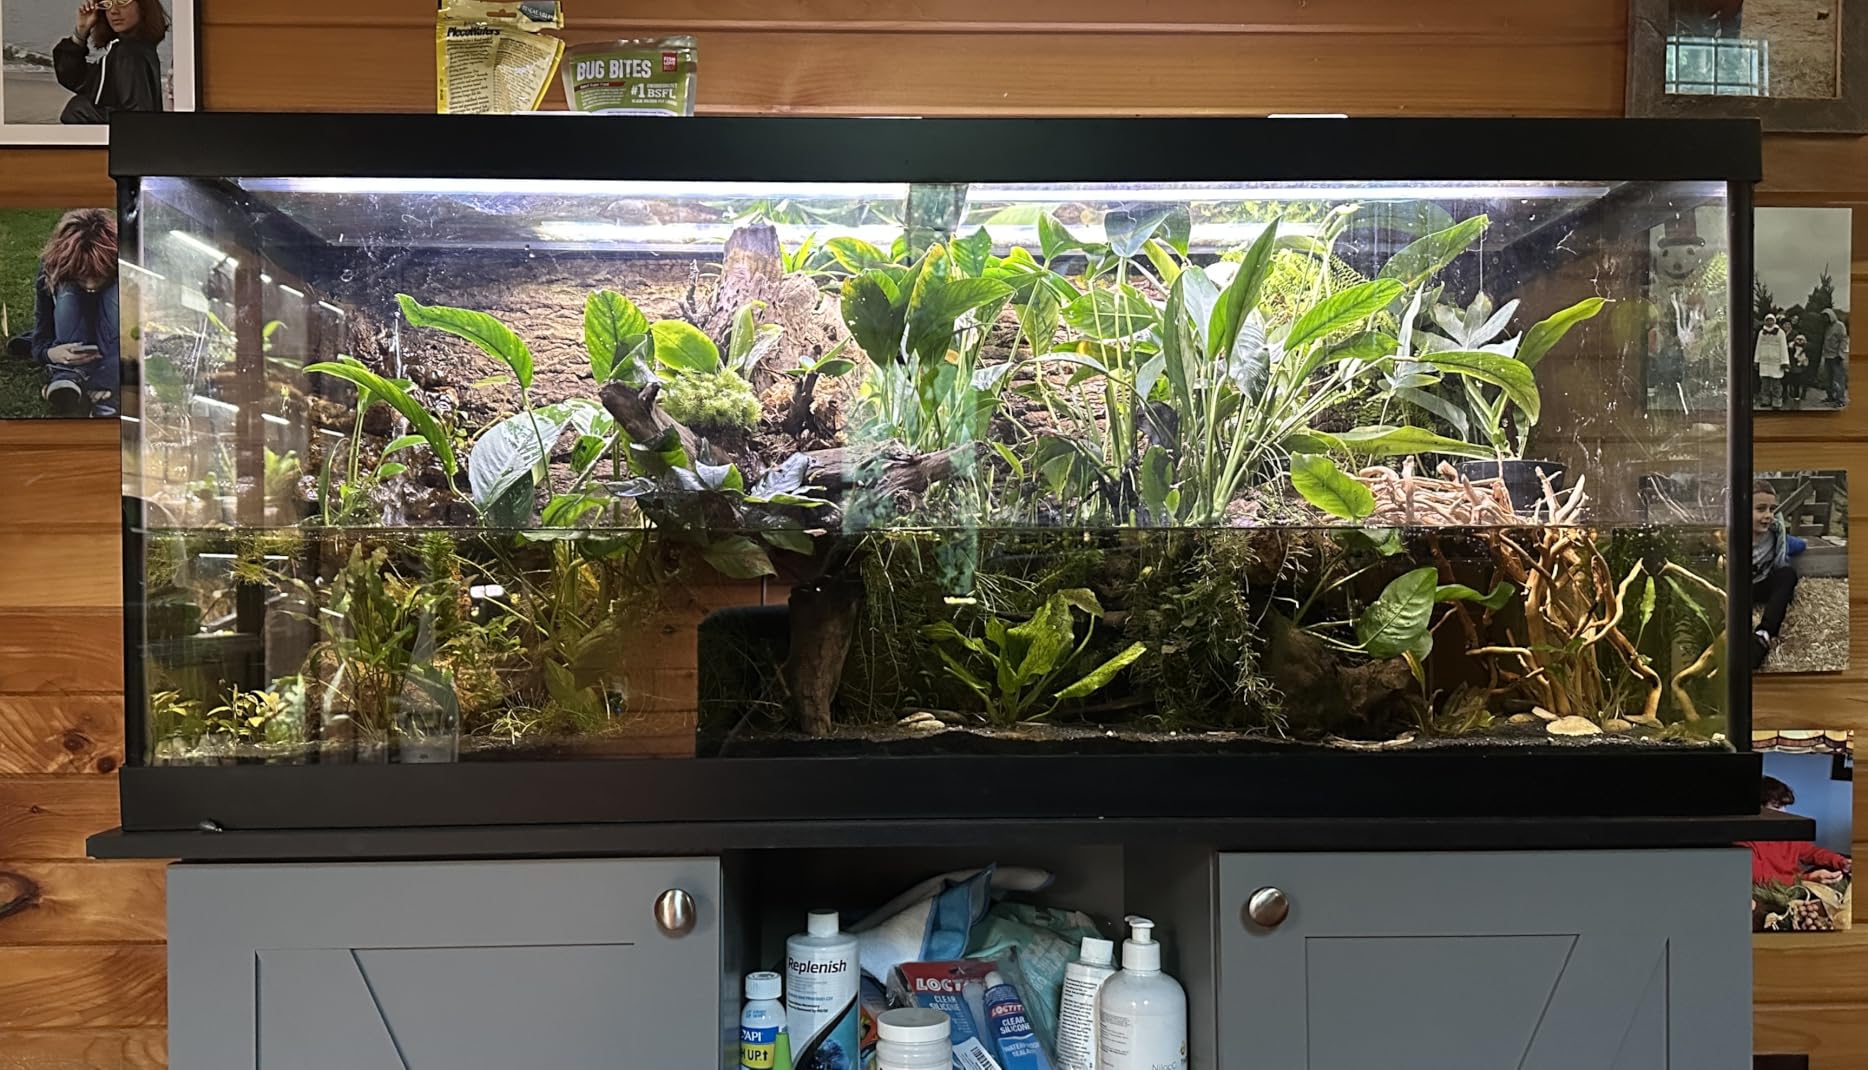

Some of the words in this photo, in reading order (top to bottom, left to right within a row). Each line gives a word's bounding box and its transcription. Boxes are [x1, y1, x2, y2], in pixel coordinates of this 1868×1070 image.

[576, 60, 605, 81] BUG
[609, 59, 652, 78] BITES
[630, 83, 645, 98] #1
[647, 88, 677, 99] BSFL
[788, 957, 847, 975] Replenish
[916, 978, 982, 992] LOCT
[934, 995, 957, 1004] CLEAR
[991, 1004, 1025, 1017] LOCTIT
[1002, 1016, 1026, 1027] CLEAR
[744, 1031, 762, 1042] API
